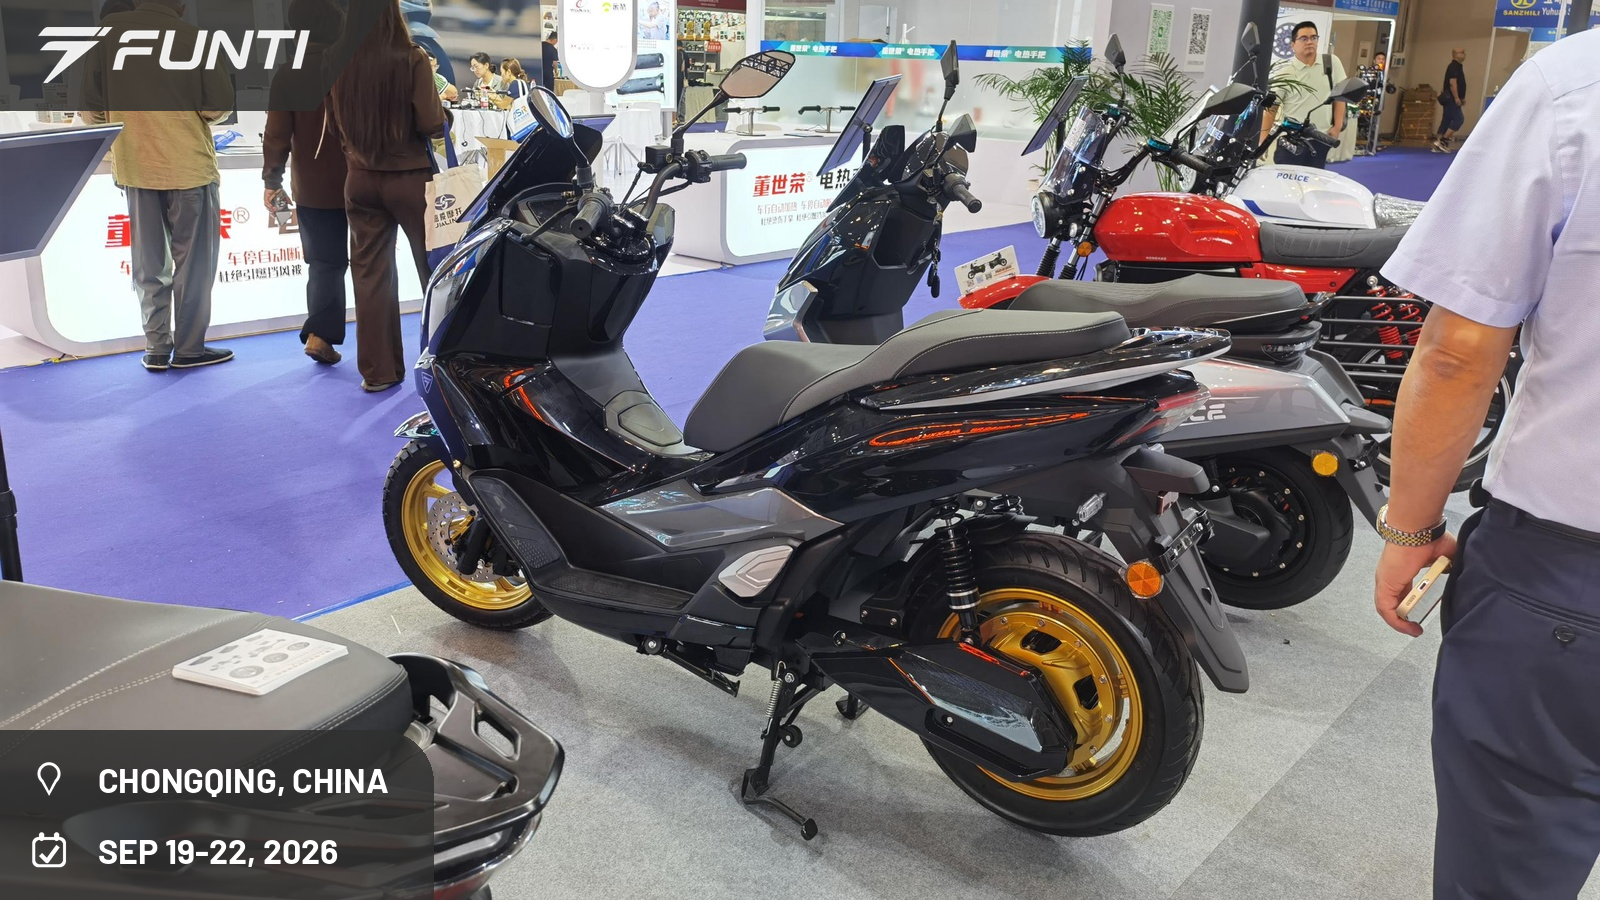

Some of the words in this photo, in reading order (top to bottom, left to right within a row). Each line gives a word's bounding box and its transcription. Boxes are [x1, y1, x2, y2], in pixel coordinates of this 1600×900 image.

[753, 173, 806, 197] 董世荣
[820, 168, 860, 190] 电热
[1276, 172, 1309, 182] POLICE
[435, 217, 457, 229] JIALIN
[228, 246, 304, 266] 车停自动断
